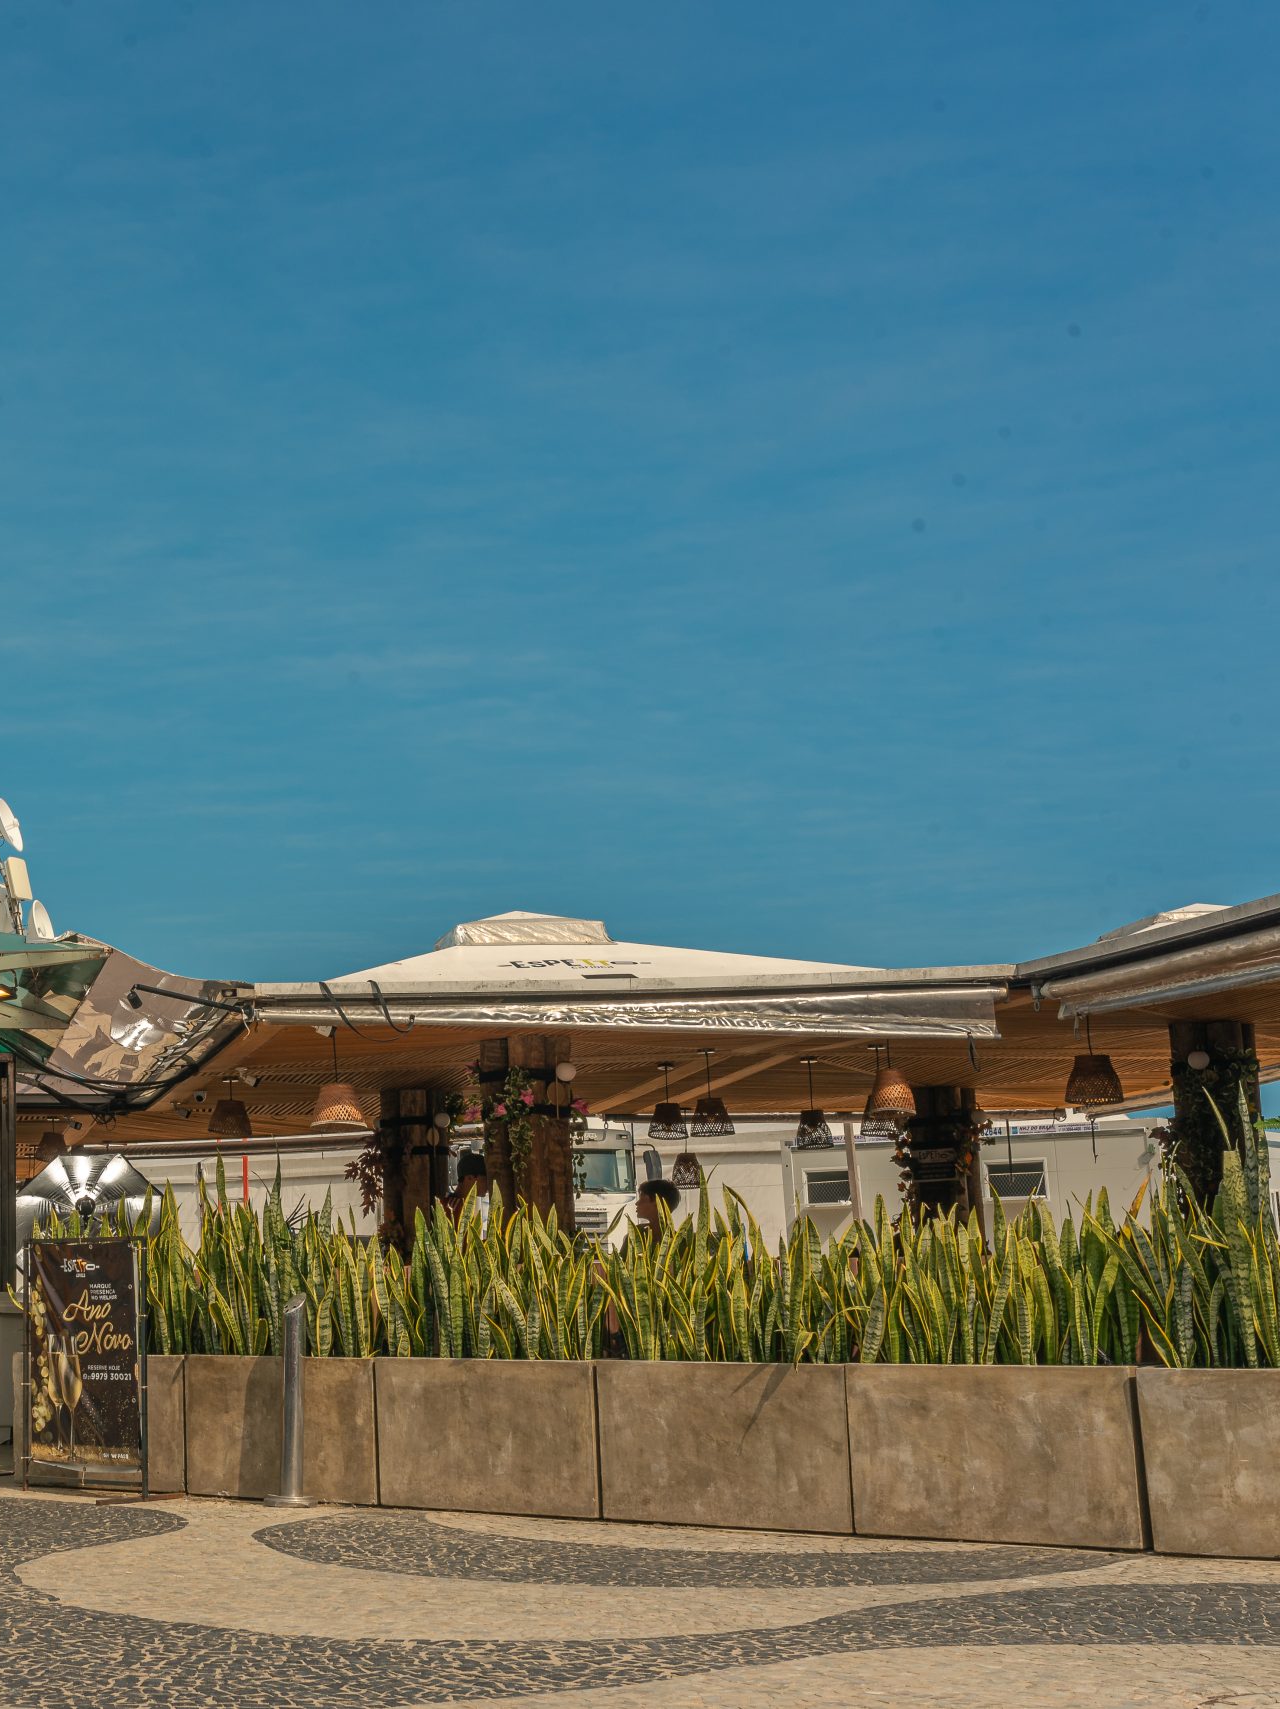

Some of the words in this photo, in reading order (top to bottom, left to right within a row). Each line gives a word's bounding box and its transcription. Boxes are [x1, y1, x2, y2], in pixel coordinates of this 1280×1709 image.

[62, 1289, 112, 1321] Ano
[76, 1321, 131, 1355] Novo
[110, 1373, 132, 1381] 30021
